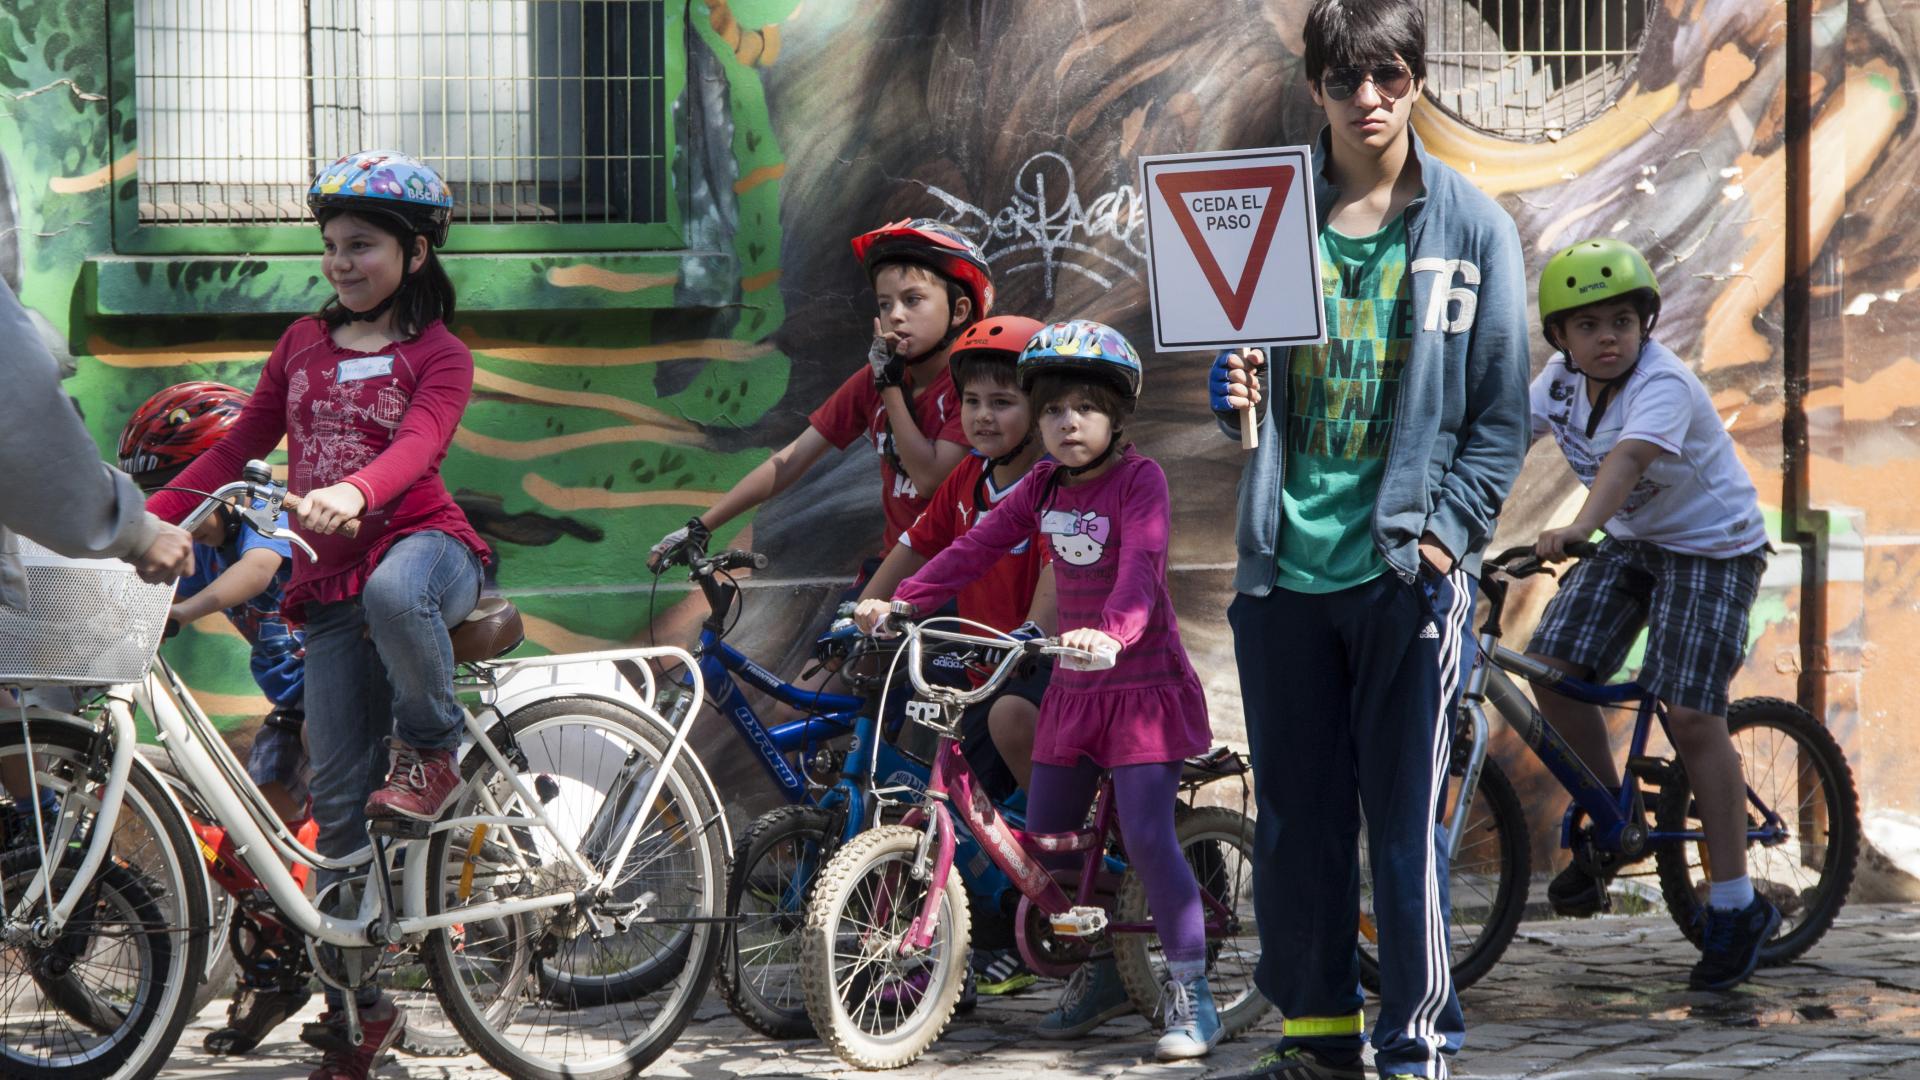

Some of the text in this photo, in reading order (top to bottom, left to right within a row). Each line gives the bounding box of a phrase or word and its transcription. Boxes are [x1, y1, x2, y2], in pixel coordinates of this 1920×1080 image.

[1192, 194, 1263, 213] CEDA EL
[1206, 214, 1251, 231] PASO
[1411, 257, 1481, 333] 76
